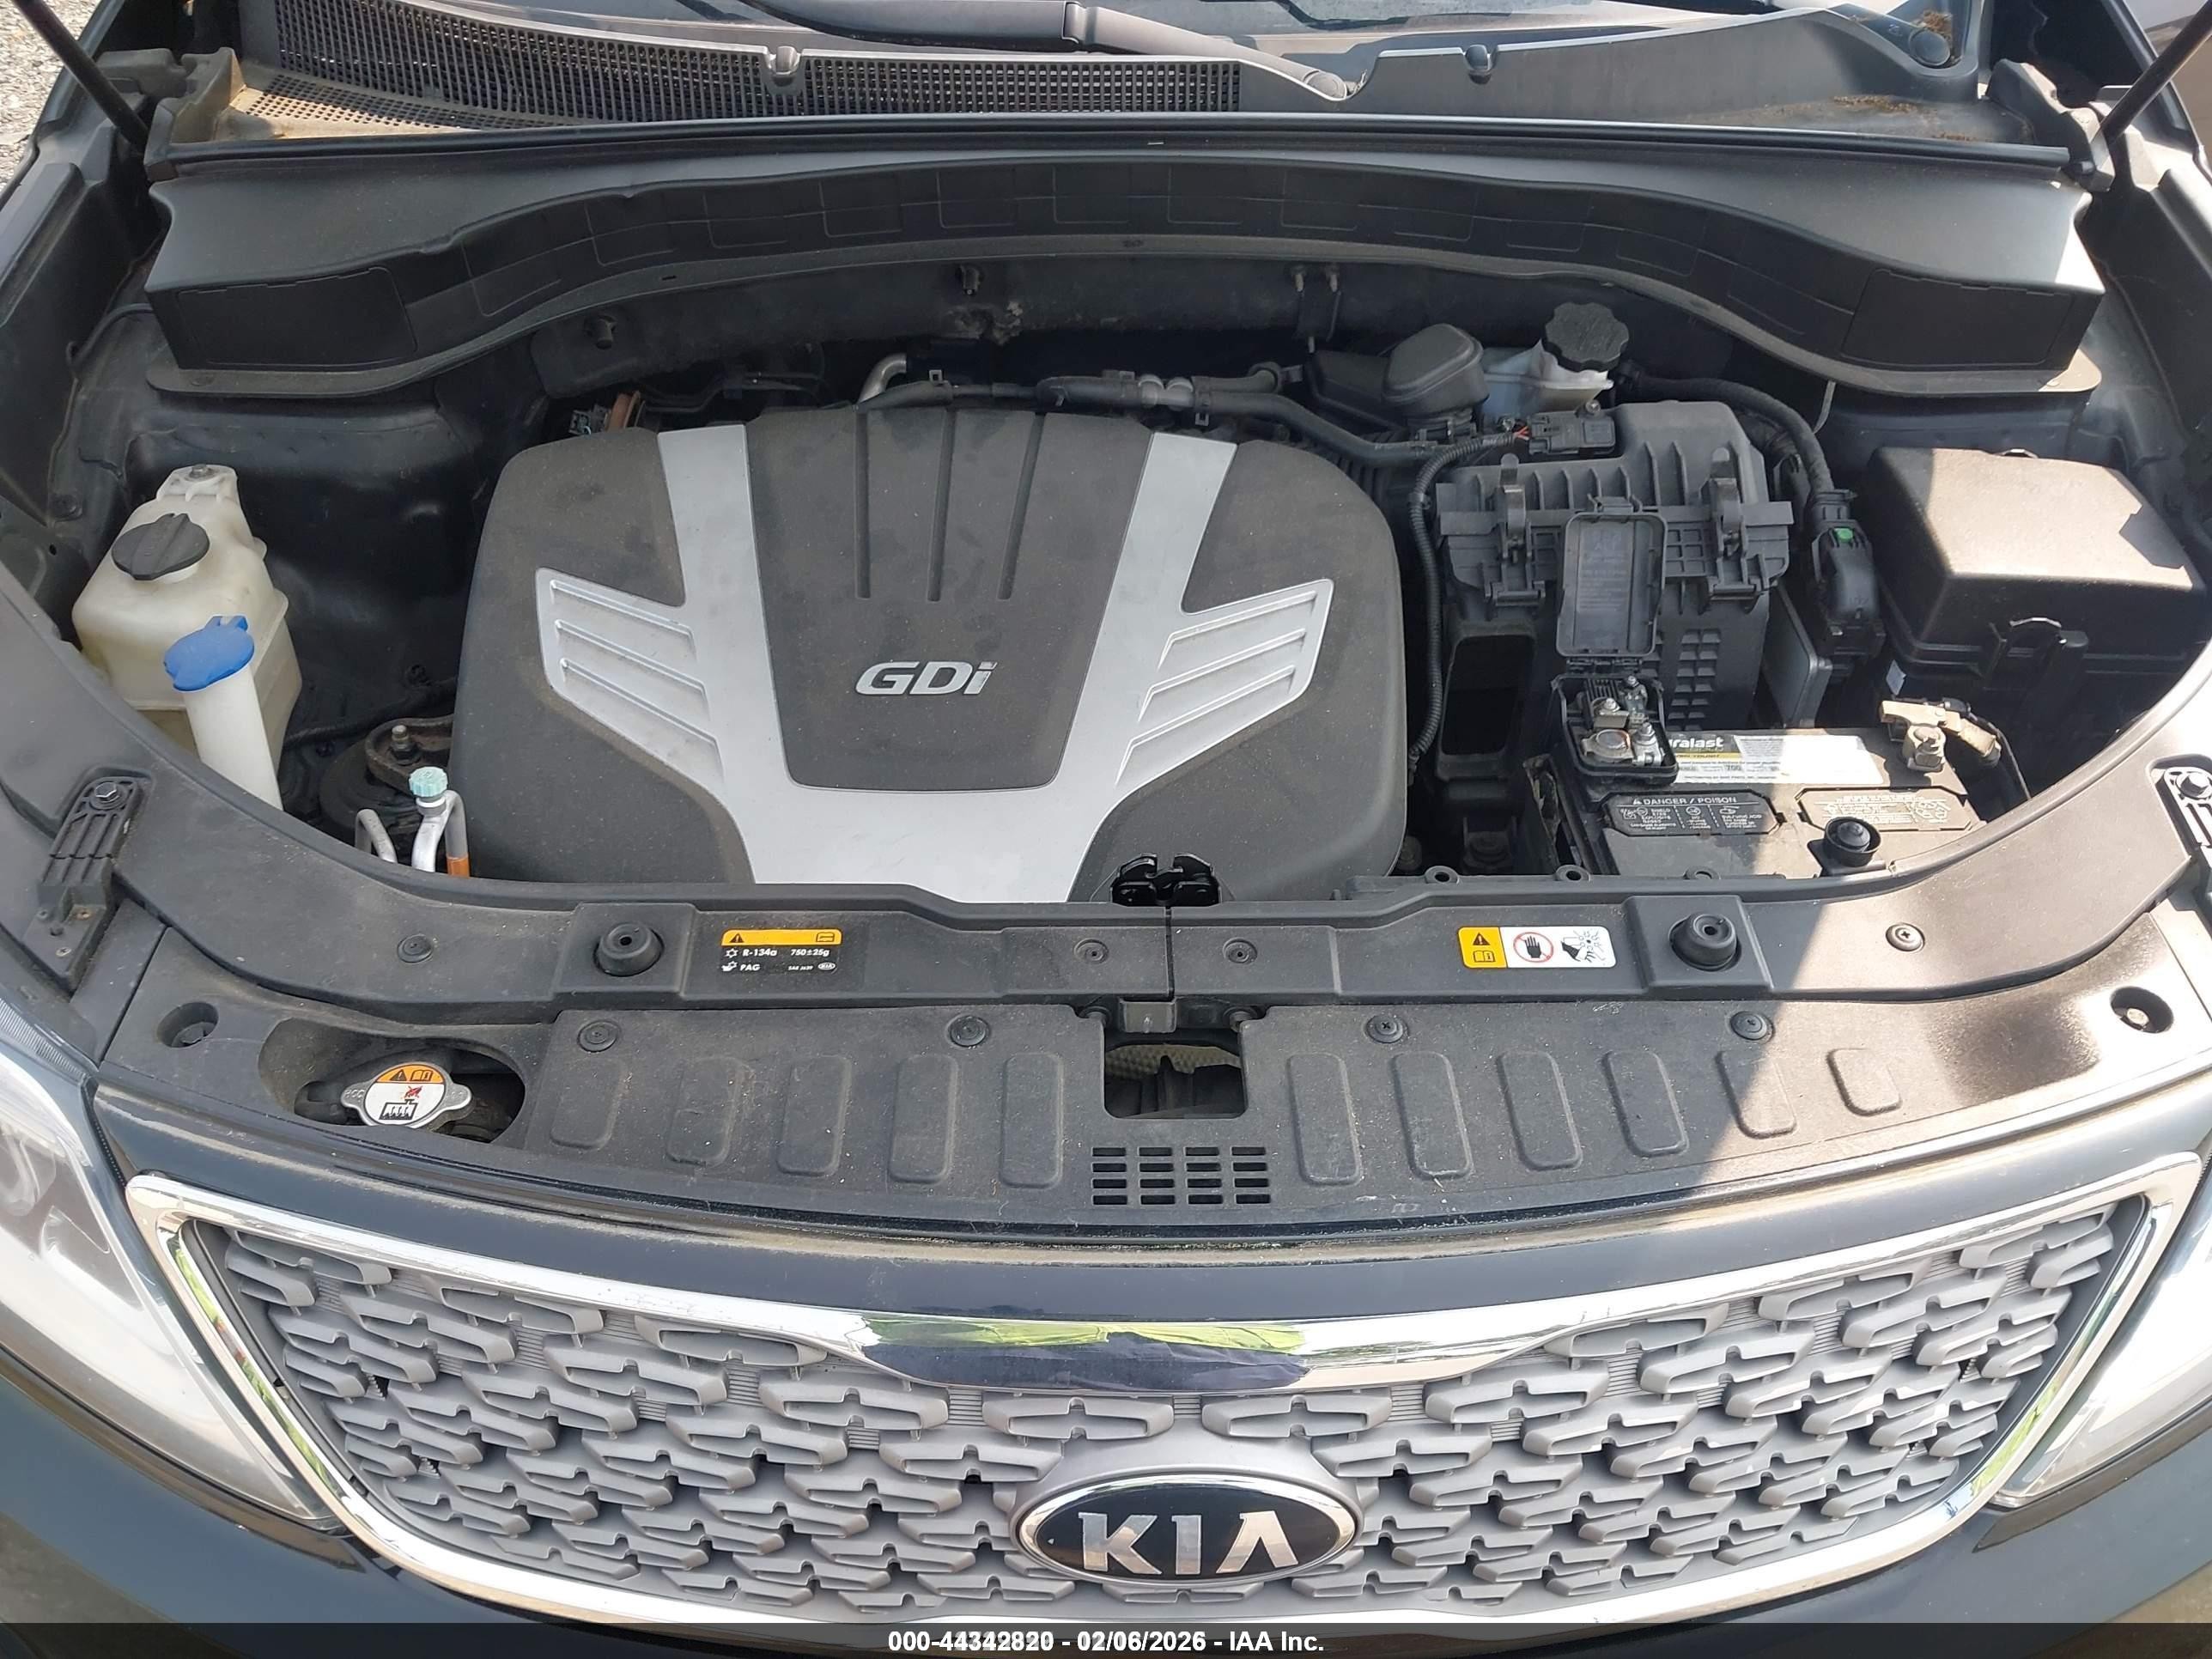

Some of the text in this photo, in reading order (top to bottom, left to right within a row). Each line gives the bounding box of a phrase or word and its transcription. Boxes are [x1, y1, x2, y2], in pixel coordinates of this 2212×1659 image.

[855, 661, 998, 695] GDi
[742, 948, 830, 957] R-134a 750±25g
[1078, 1510, 1299, 1575] KIA
